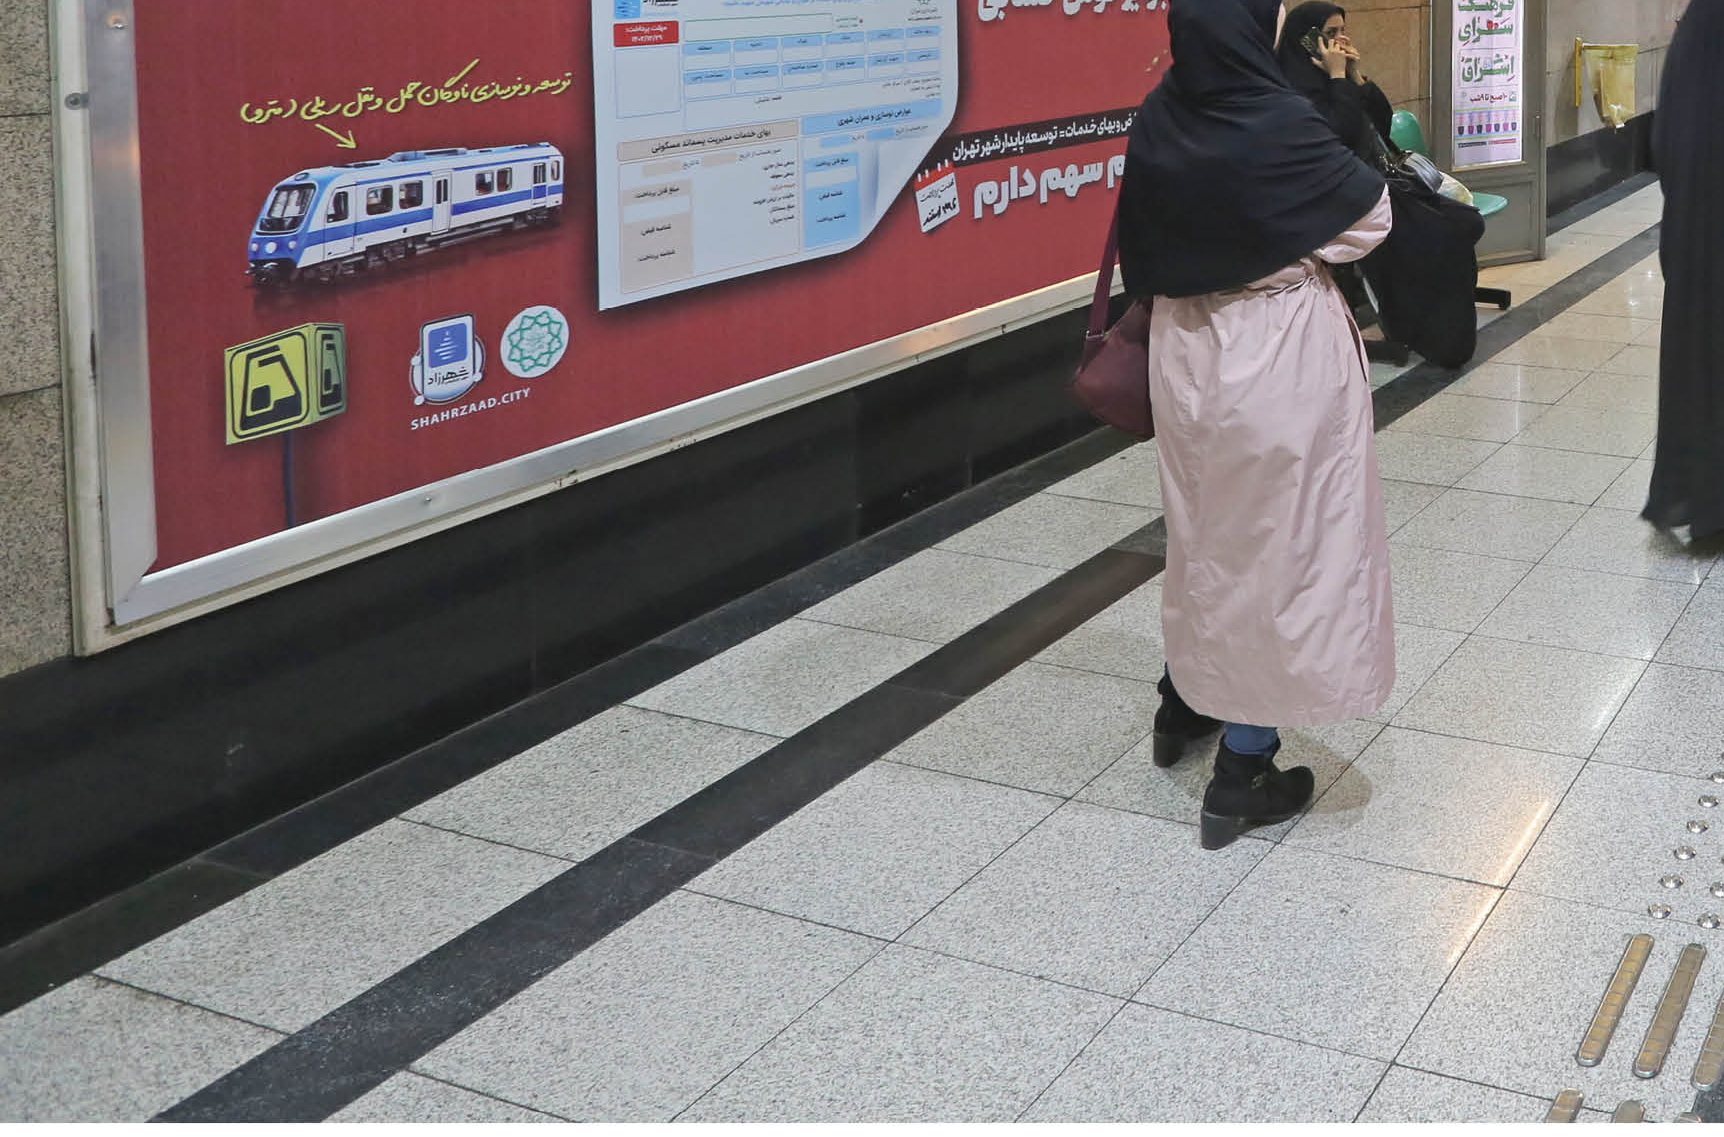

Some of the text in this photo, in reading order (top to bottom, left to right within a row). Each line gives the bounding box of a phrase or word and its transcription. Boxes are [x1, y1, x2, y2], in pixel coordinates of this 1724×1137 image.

[531, 72, 573, 95] توسعه
[386, 81, 422, 113] حمل
[1025, 125, 1058, 145] توسعه
[1065, 119, 1096, 139] خدمات
[1097, 117, 1117, 135] بهای
[952, 138, 980, 161] تهران
[979, 133, 1001, 158] شهر
[1000, 131, 1026, 153] پایدار
[973, 165, 1037, 220] دارم
[1039, 161, 1104, 204] سهم
[427, 366, 469, 386] شهرزاد
[410, 387, 531, 430] SHAHRZAAD.CITY
